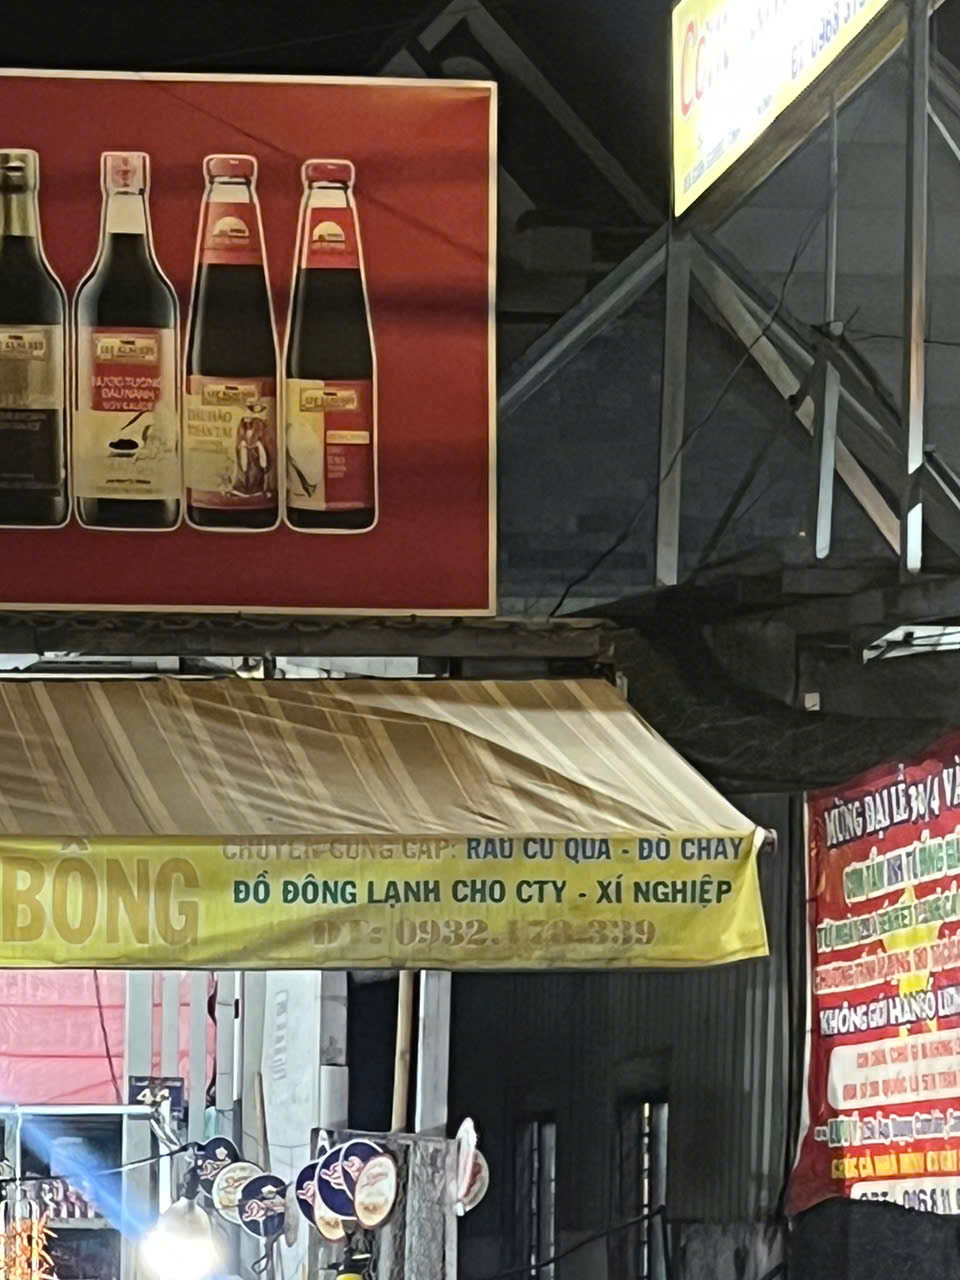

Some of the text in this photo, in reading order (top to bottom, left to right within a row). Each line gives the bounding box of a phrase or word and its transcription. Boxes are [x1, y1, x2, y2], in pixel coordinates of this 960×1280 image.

[282, 873, 357, 904] ĐÔNG
[367, 880, 441, 909] LẠNH
[451, 880, 506, 904] CHO
[515, 880, 567, 904] CTY
[596, 873, 624, 904] XÍ
[633, 874, 732, 909] NGHIỆP
